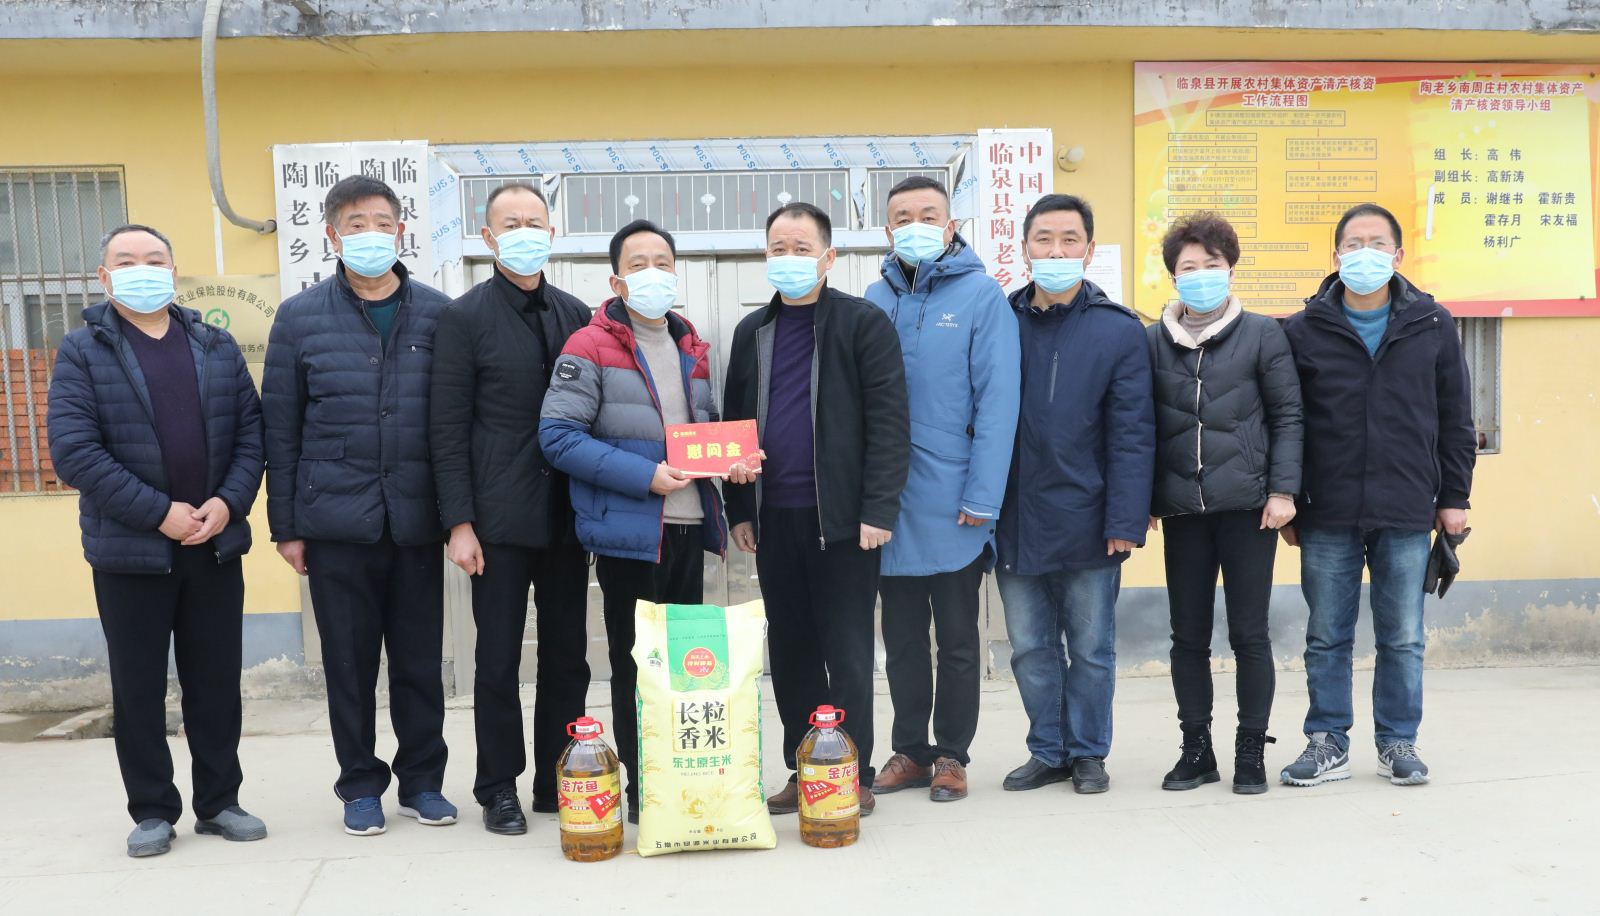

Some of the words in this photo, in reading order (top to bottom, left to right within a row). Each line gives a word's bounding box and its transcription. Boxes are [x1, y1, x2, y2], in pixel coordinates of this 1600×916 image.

[1177, 77, 1375, 90] 临泉县开展农村集体资产清产核资
[1420, 80, 1583, 95] 陶老乡南周庄村农村集体资产
[1243, 94, 1308, 107] 工作流程图
[1451, 98, 1551, 111] 清产核资领导小组
[473, 149, 488, 167] 304
[517, 148, 532, 166] 304
[561, 147, 576, 164] 304
[605, 146, 620, 164] 304
[649, 145, 664, 163] 304
[693, 145, 707, 162] 304
[736, 144, 751, 161] 304
[779, 143, 794, 160] 304
[823, 143, 838, 160] 304
[866, 142, 881, 159] 304
[909, 141, 923, 158] 304
[962, 175, 978, 189] 304
[1538, 192, 1576, 205] 霍新贵
[315, 161, 341, 263] 临县
[392, 157, 421, 274] 临泉县
[989, 142, 1016, 288] 临泉县陶老乡
[1484, 214, 1521, 227] 霍存月
[1540, 214, 1578, 227] 宋友福
[432, 224, 450, 242] SUS
[1483, 235, 1521, 248] 杨利广
[176, 285, 275, 318] 农业保险股份有限公司
[686, 442, 741, 460] 慰问金
[676, 700, 726, 725] 长粒
[677, 725, 727, 750] 香米
[672, 754, 732, 769] 东北原生米
[561, 779, 599, 793] 金龙鱼
